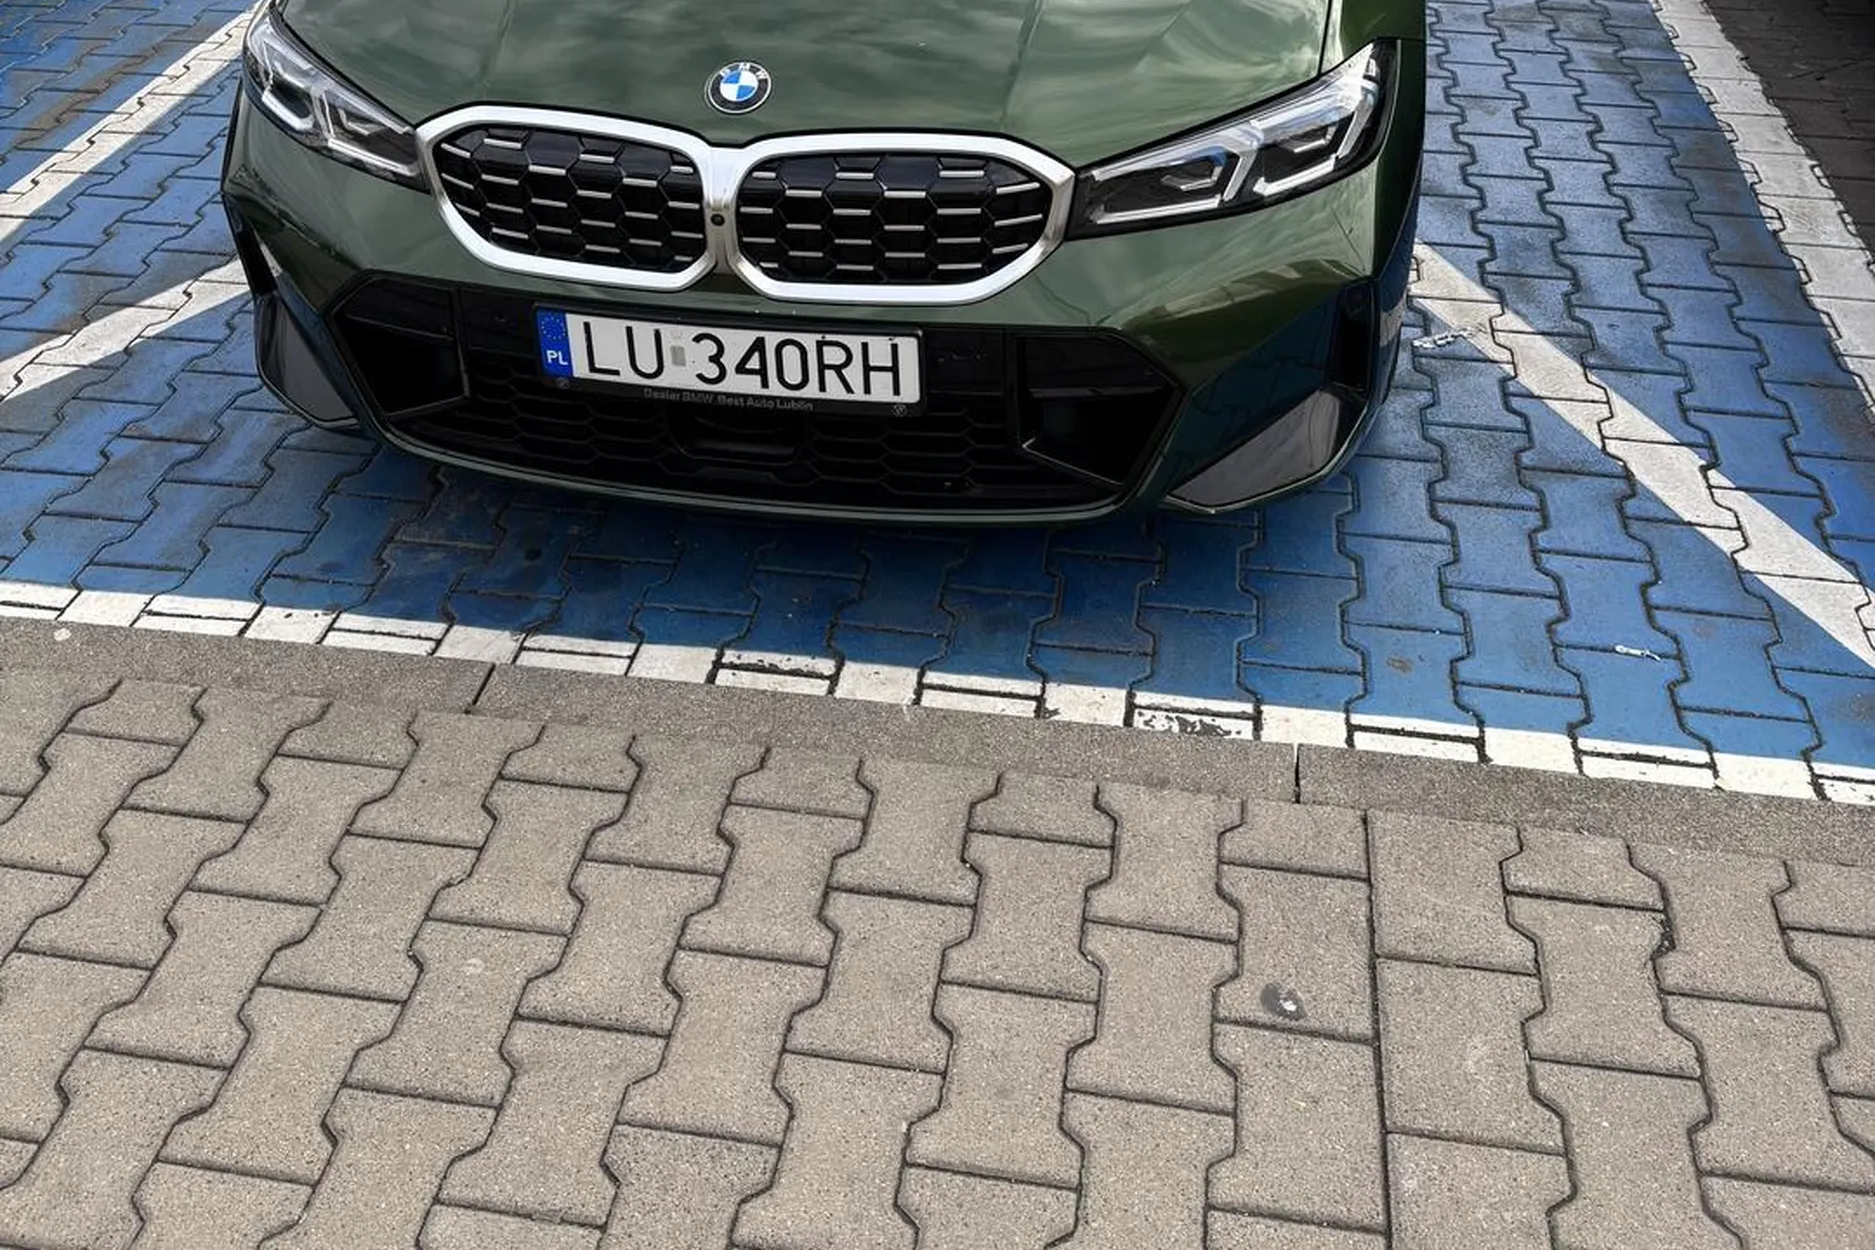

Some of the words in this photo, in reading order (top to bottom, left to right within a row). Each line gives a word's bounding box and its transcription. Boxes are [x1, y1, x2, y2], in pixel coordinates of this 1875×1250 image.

[719, 61, 768, 80] BMW
[546, 350, 569, 366] PL
[582, 321, 665, 380] LU
[690, 332, 902, 397] 340RH
[643, 388, 680, 401] Dealer
[717, 394, 745, 407] Best
[747, 397, 775, 409] Auto
[776, 399, 814, 412] Lublin
